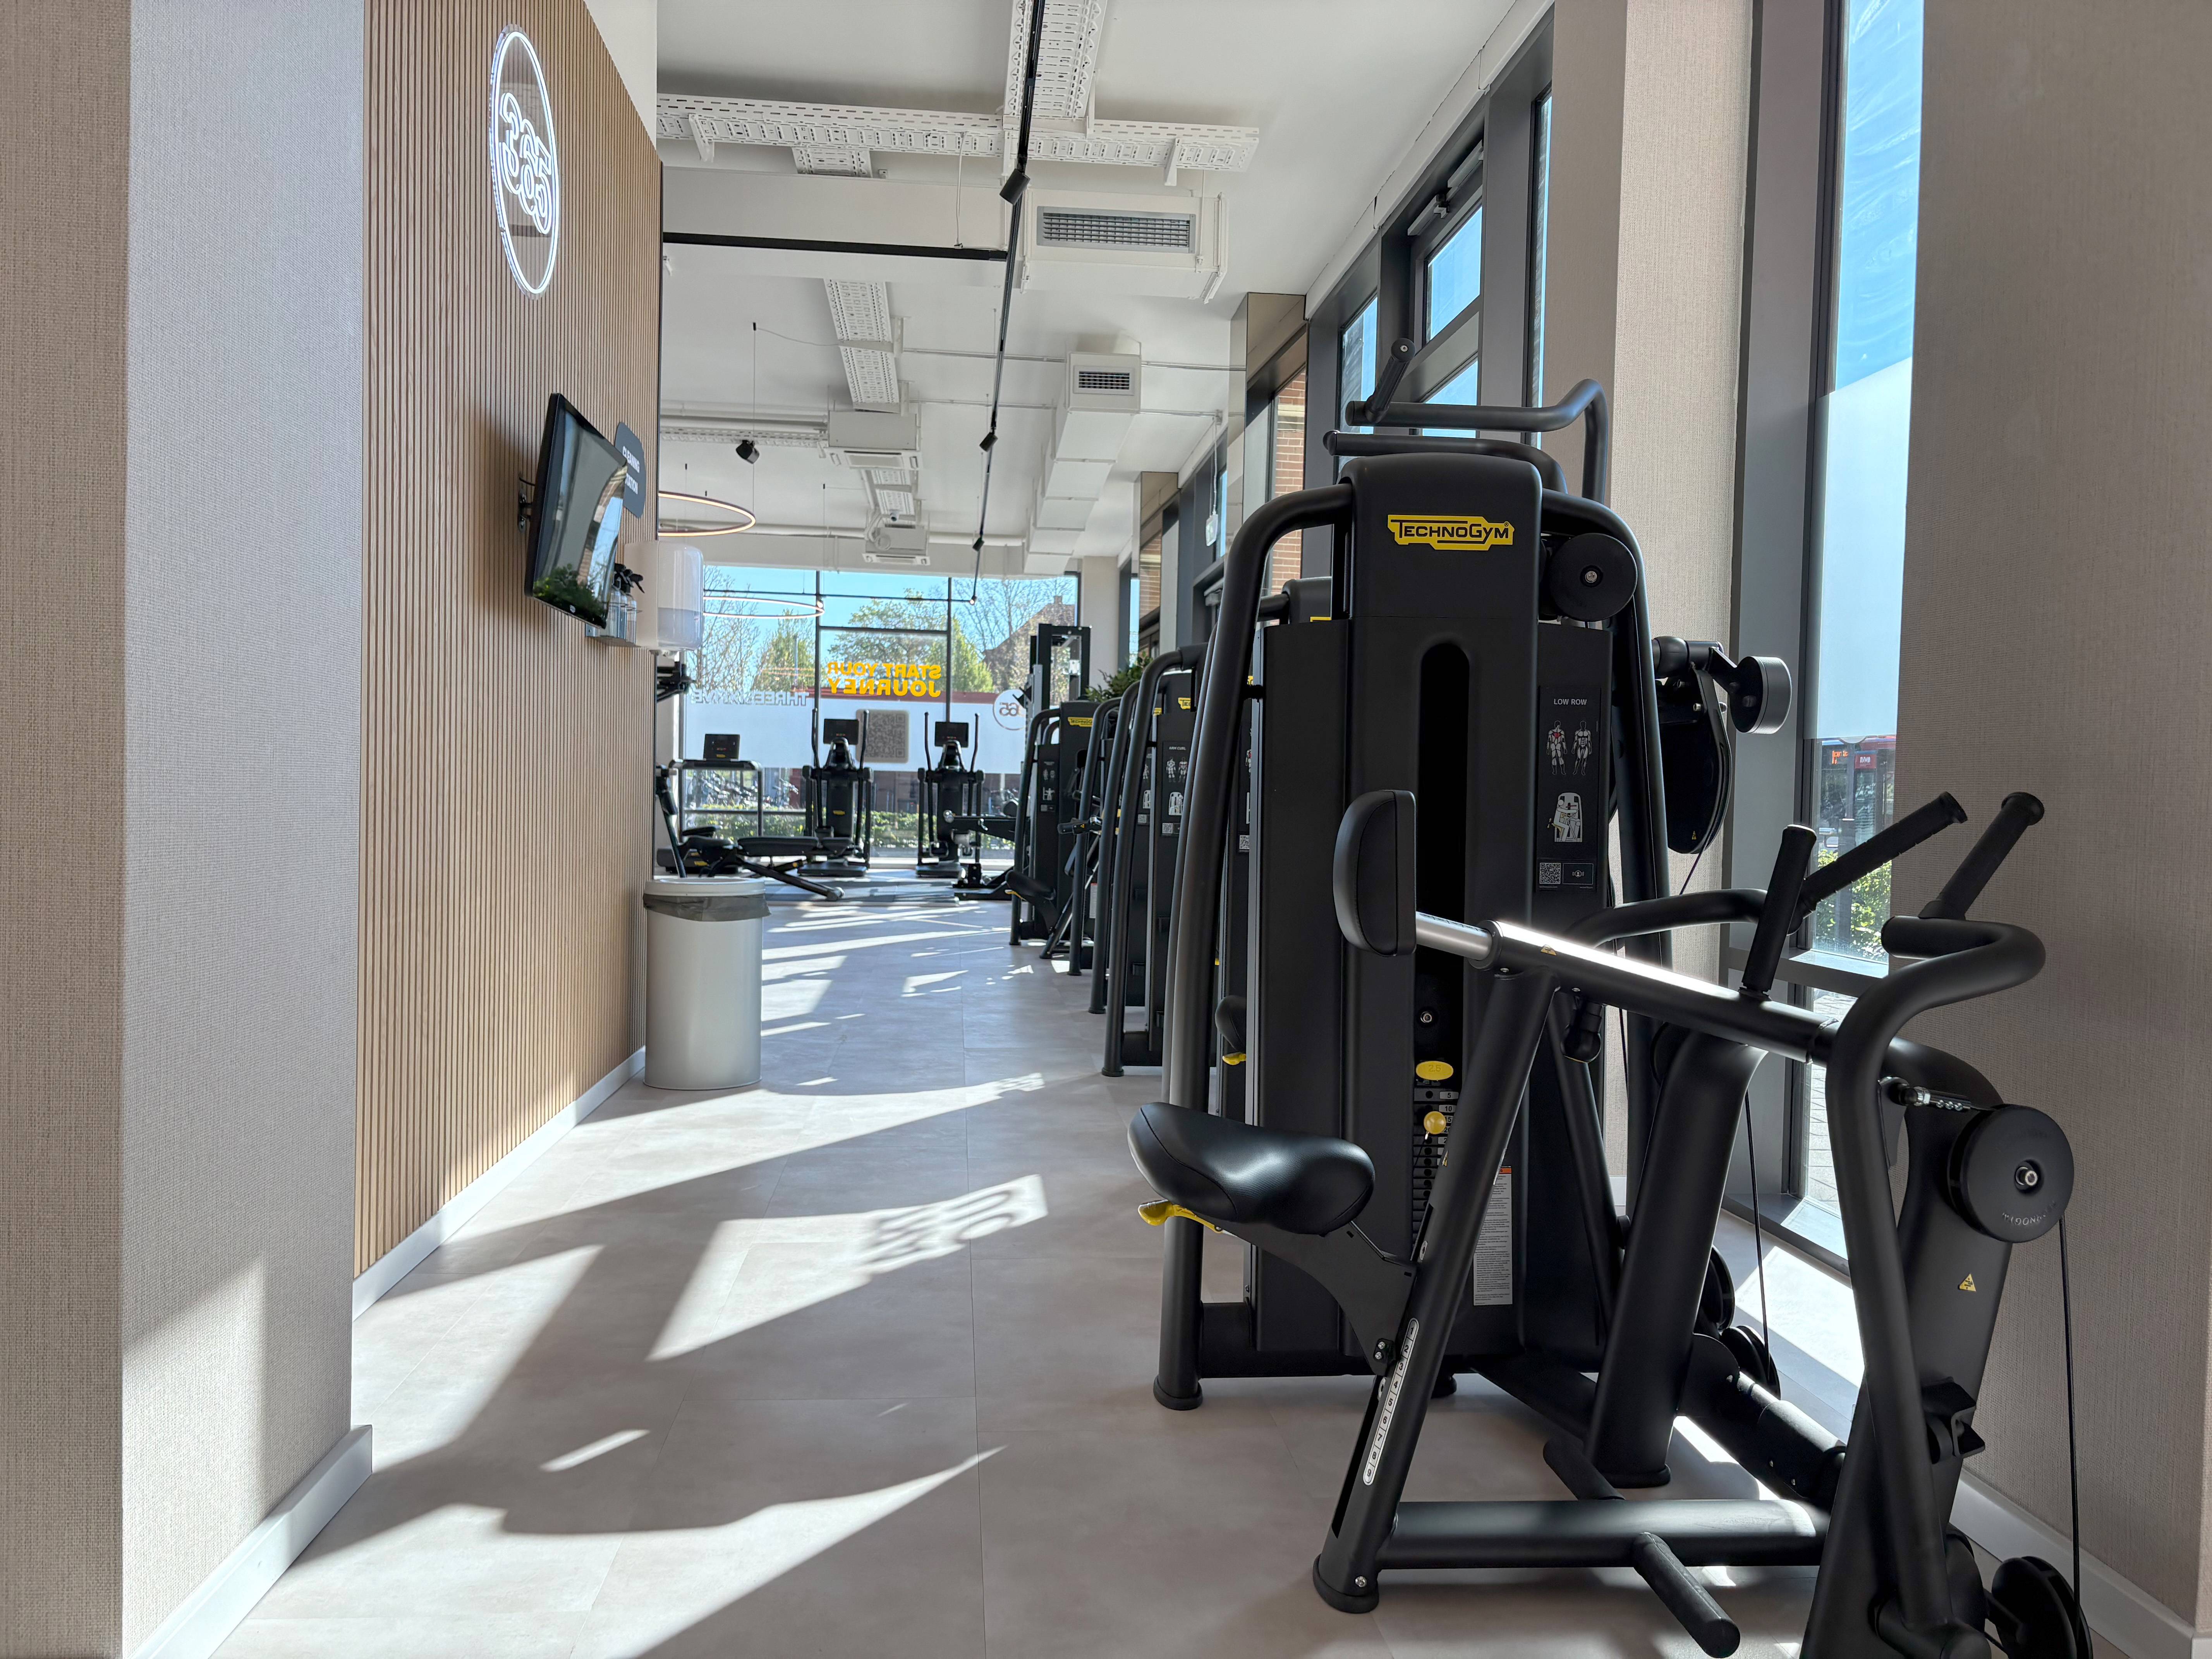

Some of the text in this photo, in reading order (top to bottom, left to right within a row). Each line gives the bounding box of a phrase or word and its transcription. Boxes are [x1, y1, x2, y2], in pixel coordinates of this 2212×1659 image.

[622, 446, 640, 473] CLEANING
[1390, 519, 1509, 544] TECHNOGYM
[1410, 1326, 1415, 1335] 1
[1404, 1344, 1409, 1353] 2
[1399, 1362, 1403, 1371] 3
[1393, 1380, 1398, 1389] 4
[1388, 1398, 1393, 1407] 5
[1382, 1416, 1387, 1425] 6
[1377, 1433, 1382, 1442] 7
[1372, 1451, 1377, 1460] 8
